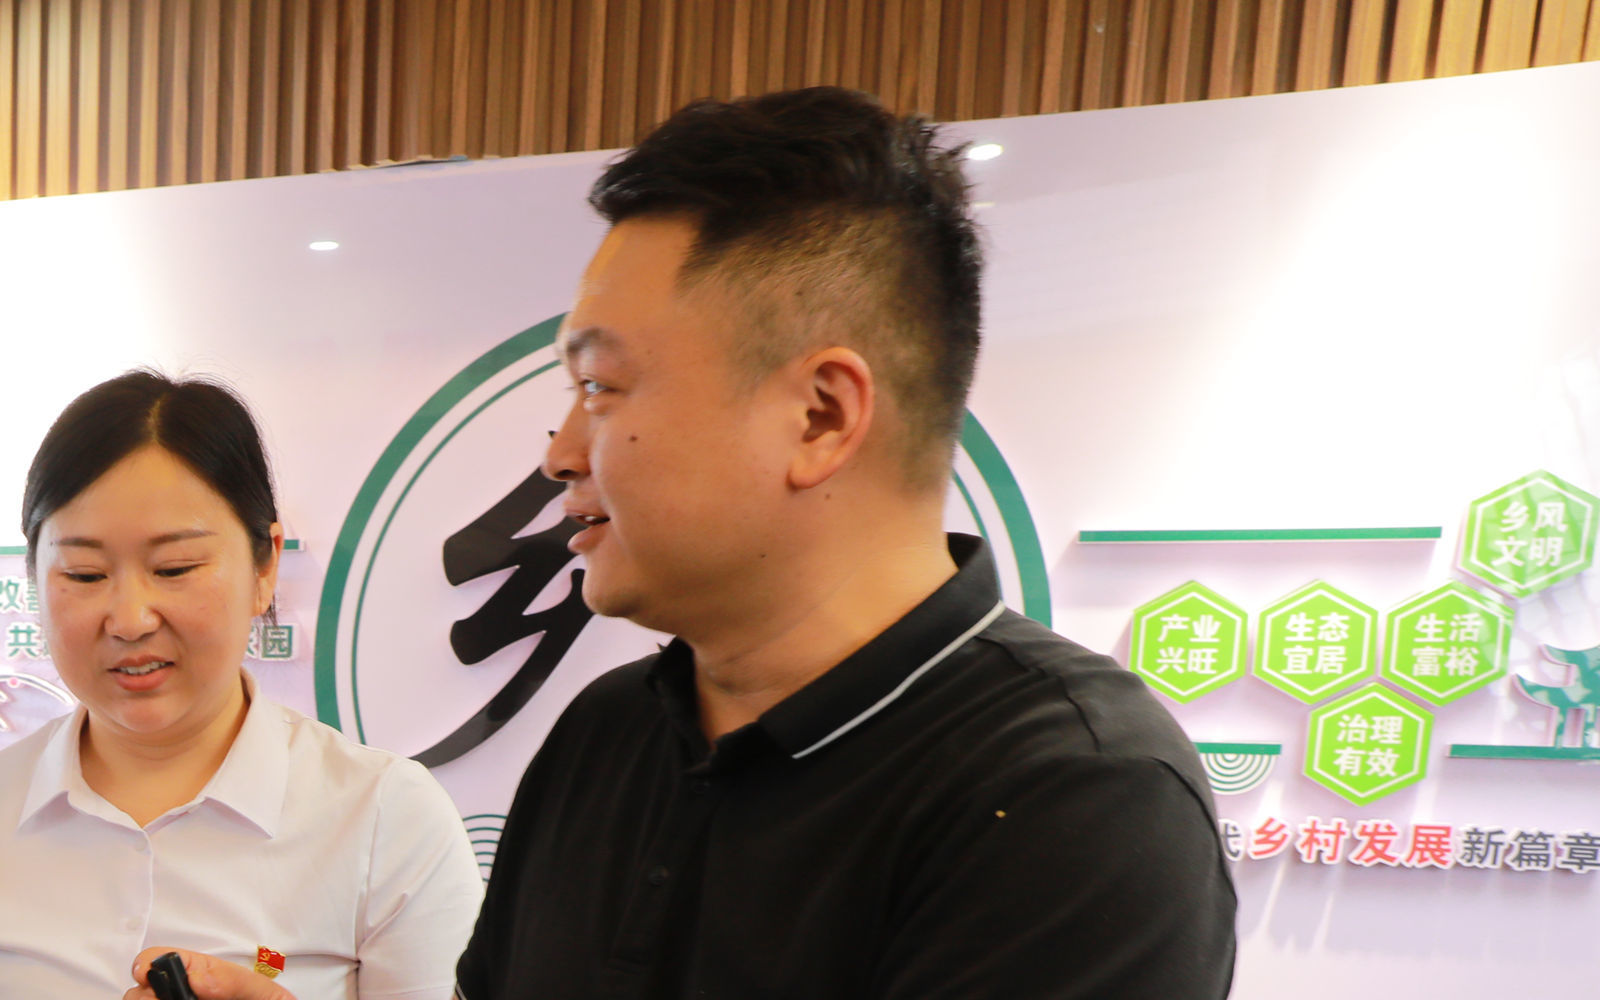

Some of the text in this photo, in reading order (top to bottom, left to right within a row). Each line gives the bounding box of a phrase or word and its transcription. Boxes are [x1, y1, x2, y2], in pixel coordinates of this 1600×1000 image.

[1500, 500, 1569, 535] 乡风
[1494, 534, 1565, 569] 文明
[1157, 613, 1221, 645] 产业
[1284, 611, 1351, 643] 生态
[1414, 612, 1483, 644] 生活
[1156, 645, 1220, 677] 兴旺
[1283, 645, 1348, 677] 宜居
[1411, 646, 1480, 679] 富裕
[1337, 713, 1403, 746] 治理
[1334, 746, 1400, 779] 有效
